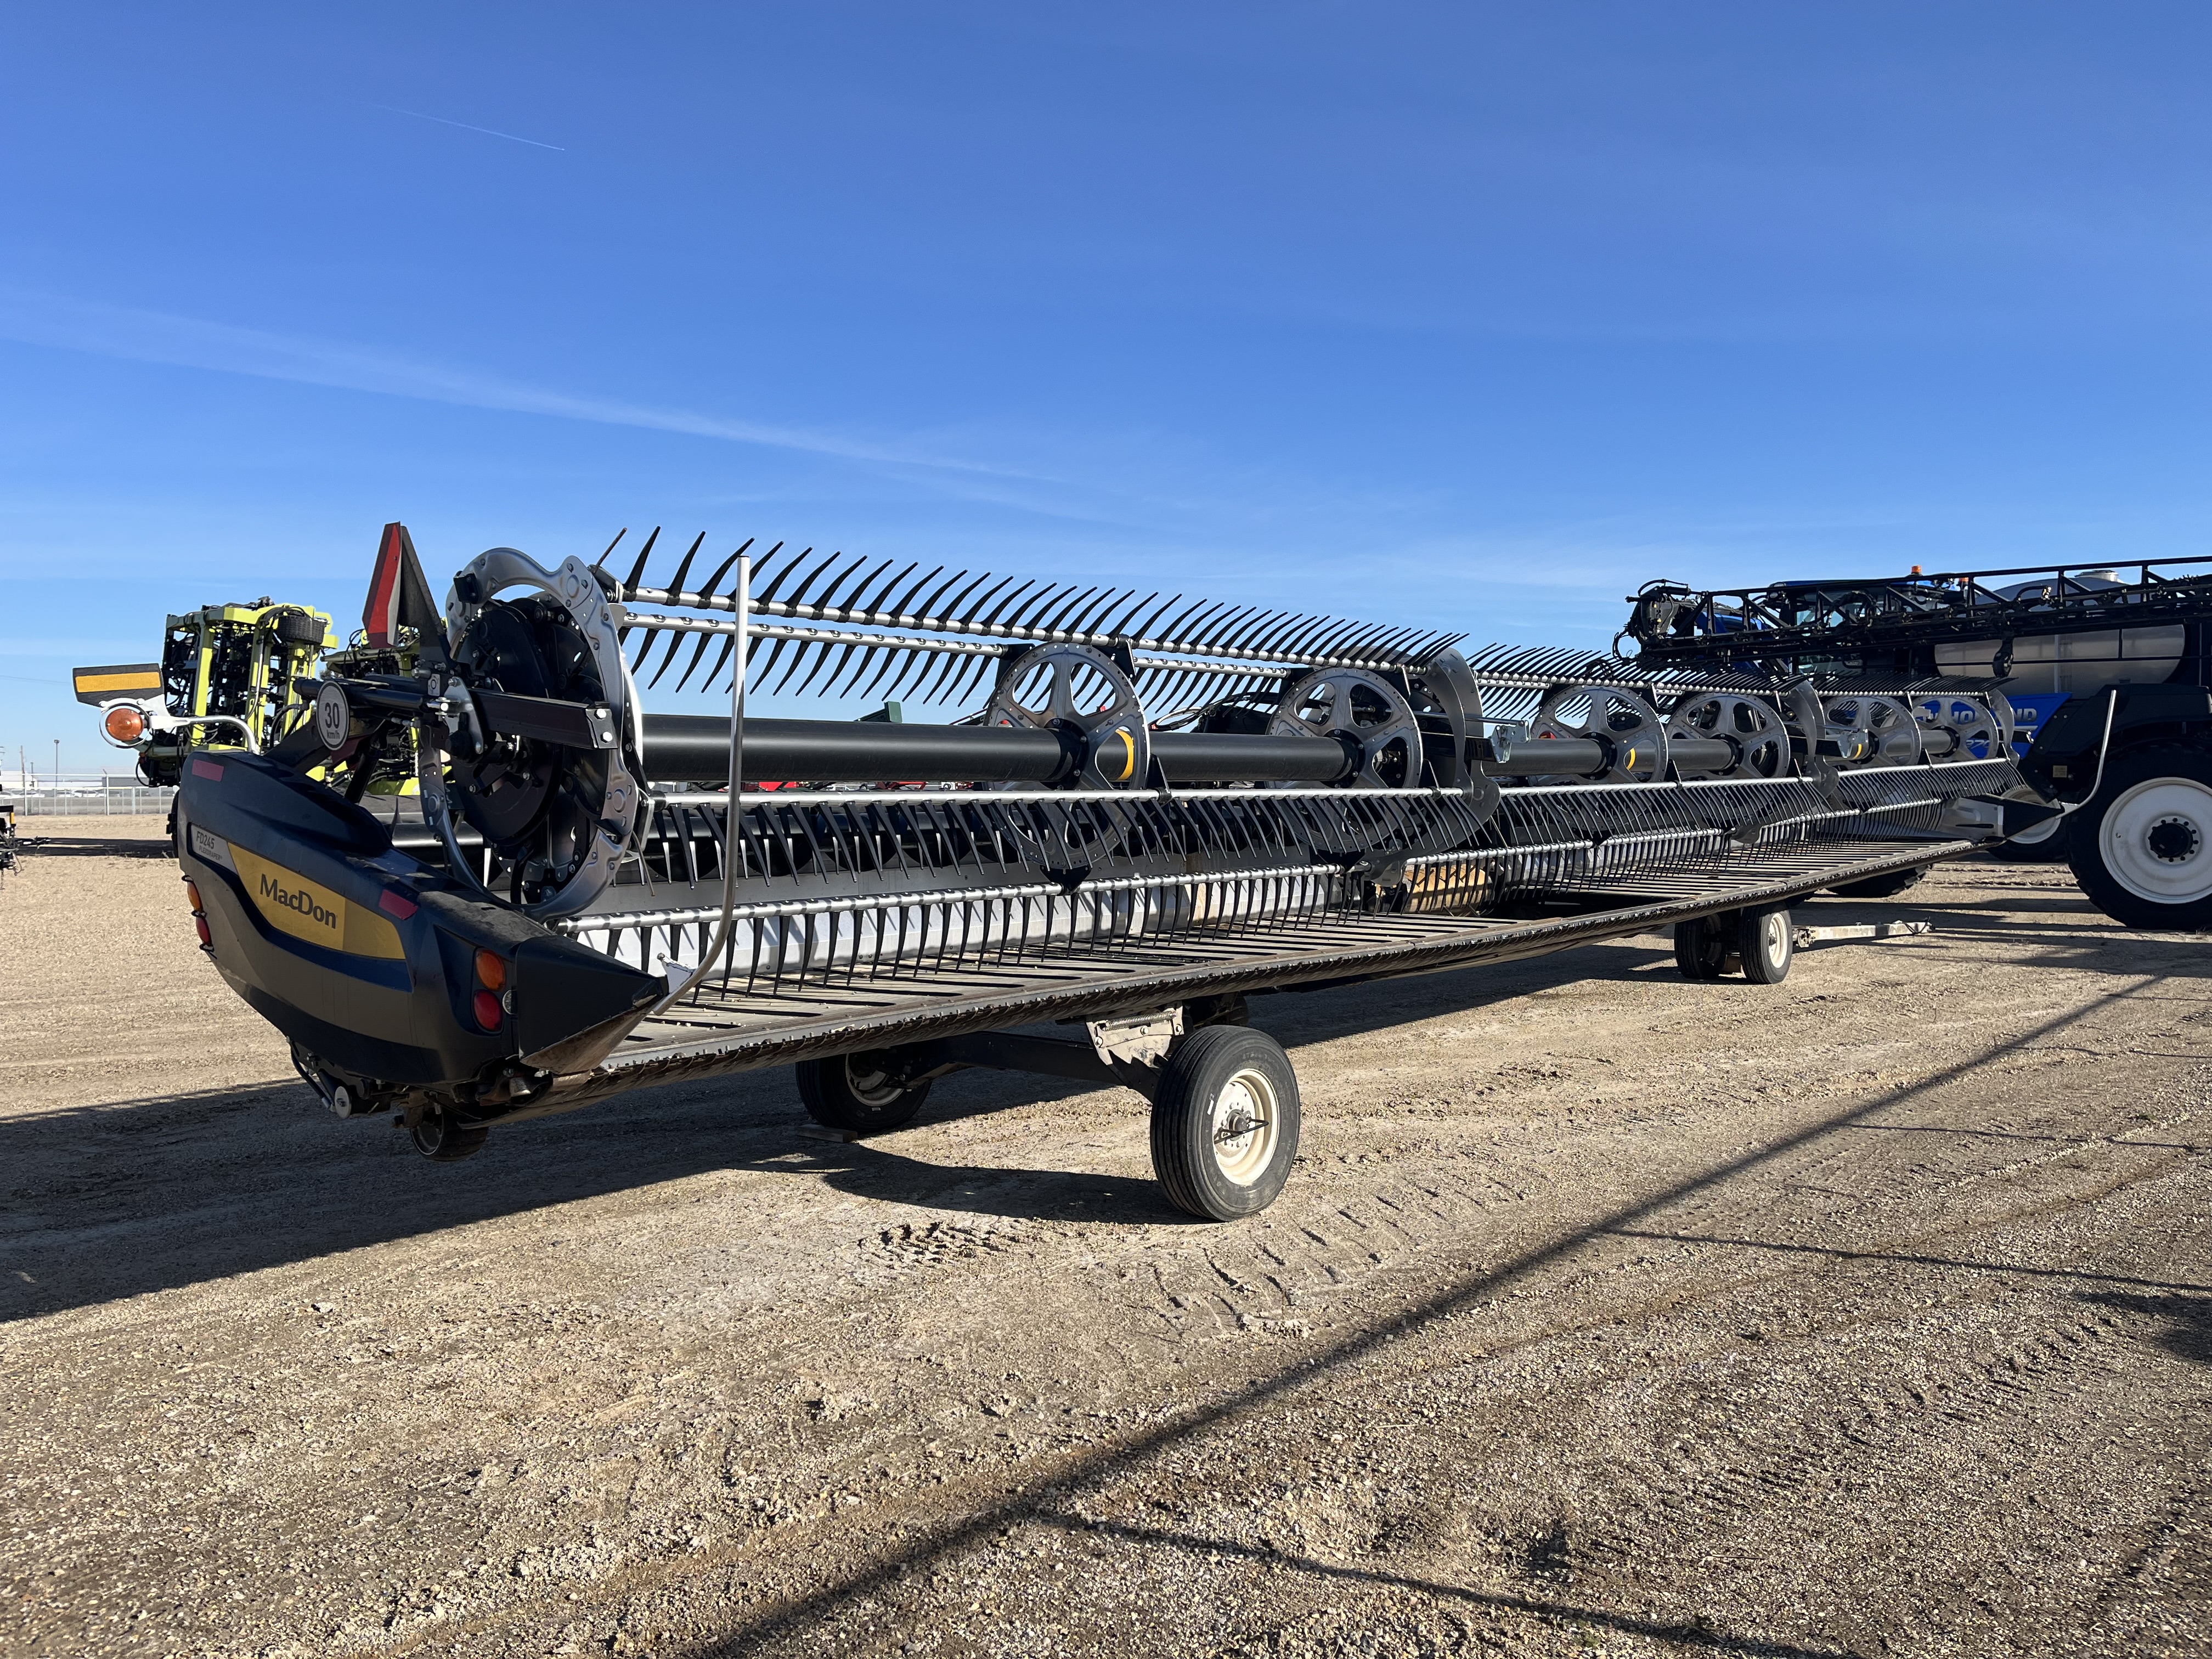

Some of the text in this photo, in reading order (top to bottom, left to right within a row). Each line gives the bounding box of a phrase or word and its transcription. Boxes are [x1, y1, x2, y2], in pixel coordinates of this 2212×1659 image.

[325, 702, 340, 729] 30
[326, 729, 340, 740] km/h
[196, 831, 215, 849] FD245
[260, 873, 336, 929] MacDon
